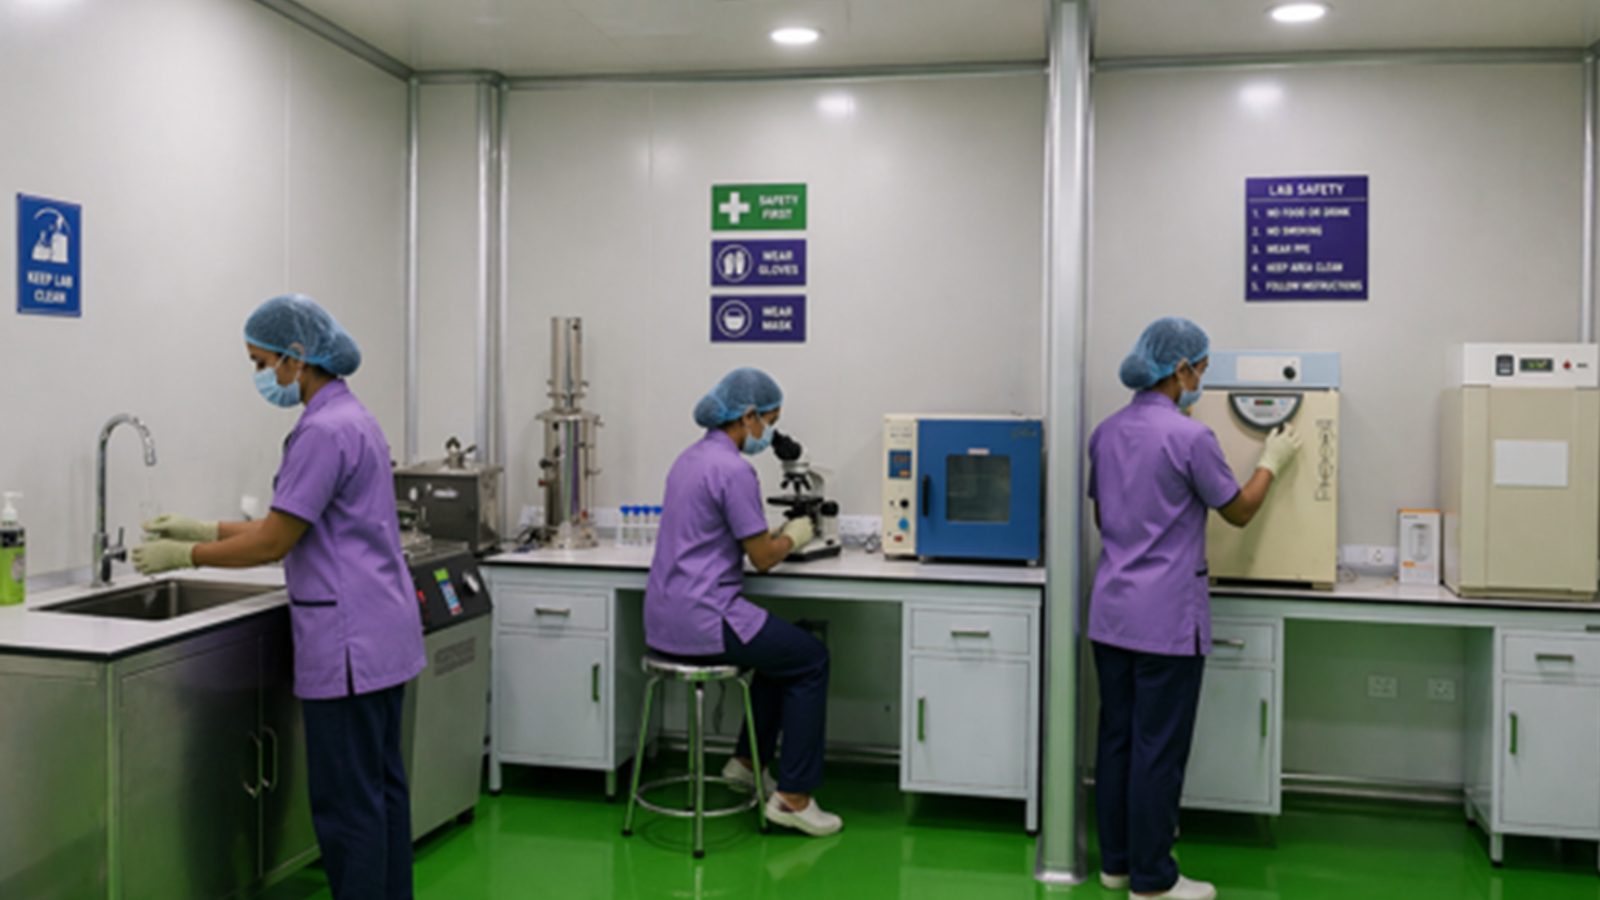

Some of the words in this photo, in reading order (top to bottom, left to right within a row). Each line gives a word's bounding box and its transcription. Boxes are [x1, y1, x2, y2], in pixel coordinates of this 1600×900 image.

[1268, 184, 1293, 196] LAB
[1297, 183, 1344, 195] SAFETY
[759, 195, 798, 206] SAFETY
[1266, 208, 1279, 217] NO
[1283, 207, 1305, 217] FOOD
[1309, 207, 1320, 217] OR
[1266, 227, 1279, 236] NO
[1283, 226, 1322, 236] SMOKING
[1266, 244, 1291, 254] WEAR
[762, 250, 793, 261] WEAR
[758, 264, 798, 275] GLOVES
[1266, 262, 1288, 273] KEEP
[1290, 262, 1313, 273] AREA
[1315, 262, 1343, 272] CLEAN
[28, 271, 52, 286] KEEP
[54, 274, 73, 288] LAB
[1266, 281, 1299, 291] FOLLOW
[1301, 280, 1363, 291] INSTRUCTIONS
[34, 288, 66, 303] CLEAN
[762, 306, 793, 317] WEAR
[762, 320, 793, 331] MASK
